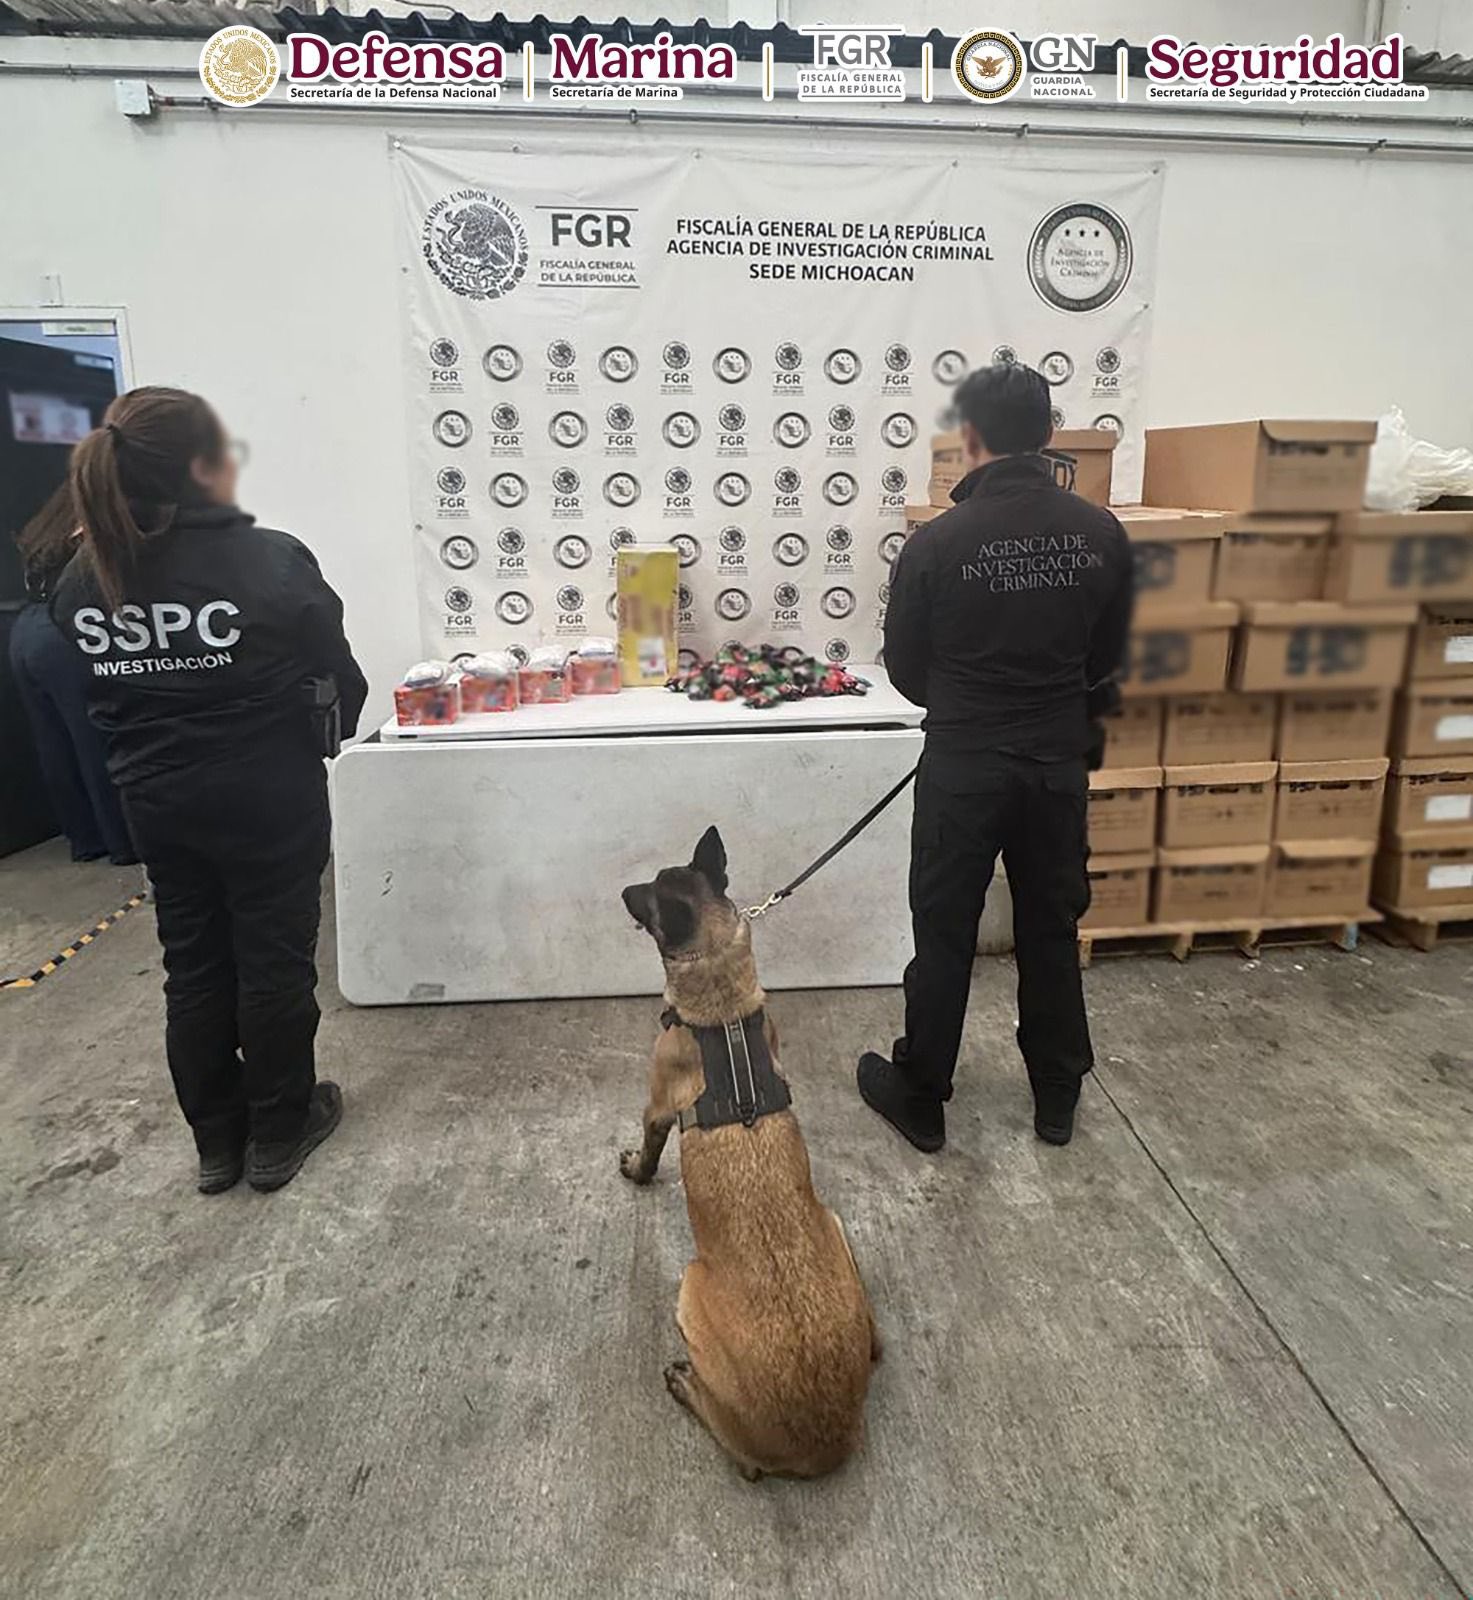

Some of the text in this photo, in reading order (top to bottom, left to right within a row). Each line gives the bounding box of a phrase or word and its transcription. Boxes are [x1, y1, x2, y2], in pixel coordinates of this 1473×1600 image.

[551, 213, 632, 248] FGR
[677, 215, 986, 242] FISCALÍA GENERAL DE LA REPÚBLICA
[666, 239, 994, 261] AGENCIA DE INVESTIGACIÓN CRIMINAL
[587, 261, 636, 270] GENERAL
[541, 272, 556, 281] DE
[560, 273, 573, 282] LA
[749, 263, 914, 281] SEDE MICHOACAN
[432, 371, 458, 382] FGR
[549, 372, 575, 383] FGR
[664, 373, 689, 384] FGR
[775, 373, 801, 384] FGR
[885, 374, 909, 385] FGR
[1095, 377, 1118, 388] FGR
[493, 435, 519, 446] FGR
[608, 435, 633, 446] FGR
[720, 436, 744, 446] FGR
[829, 436, 853, 446] FGR
[440, 497, 465, 508] FGR
[554, 497, 579, 508] FGR
[666, 497, 691, 507] FGR
[775, 496, 800, 507] FGR
[882, 496, 906, 506] FGR
[978, 533, 1089, 559] AGENCIA DE
[499, 557, 524, 568] FGR
[720, 555, 745, 566] FGR
[827, 554, 851, 564] FGR
[962, 552, 1104, 580] INVESTIGACIÓN
[990, 571, 1080, 593] CRIMINAL
[447, 615, 472, 626] FGR
[558, 614, 583, 625] FGR
[774, 610, 799, 621] FGR
[74, 600, 241, 655] SSPC
[93, 651, 233, 677] INVESTIGACIÓN
